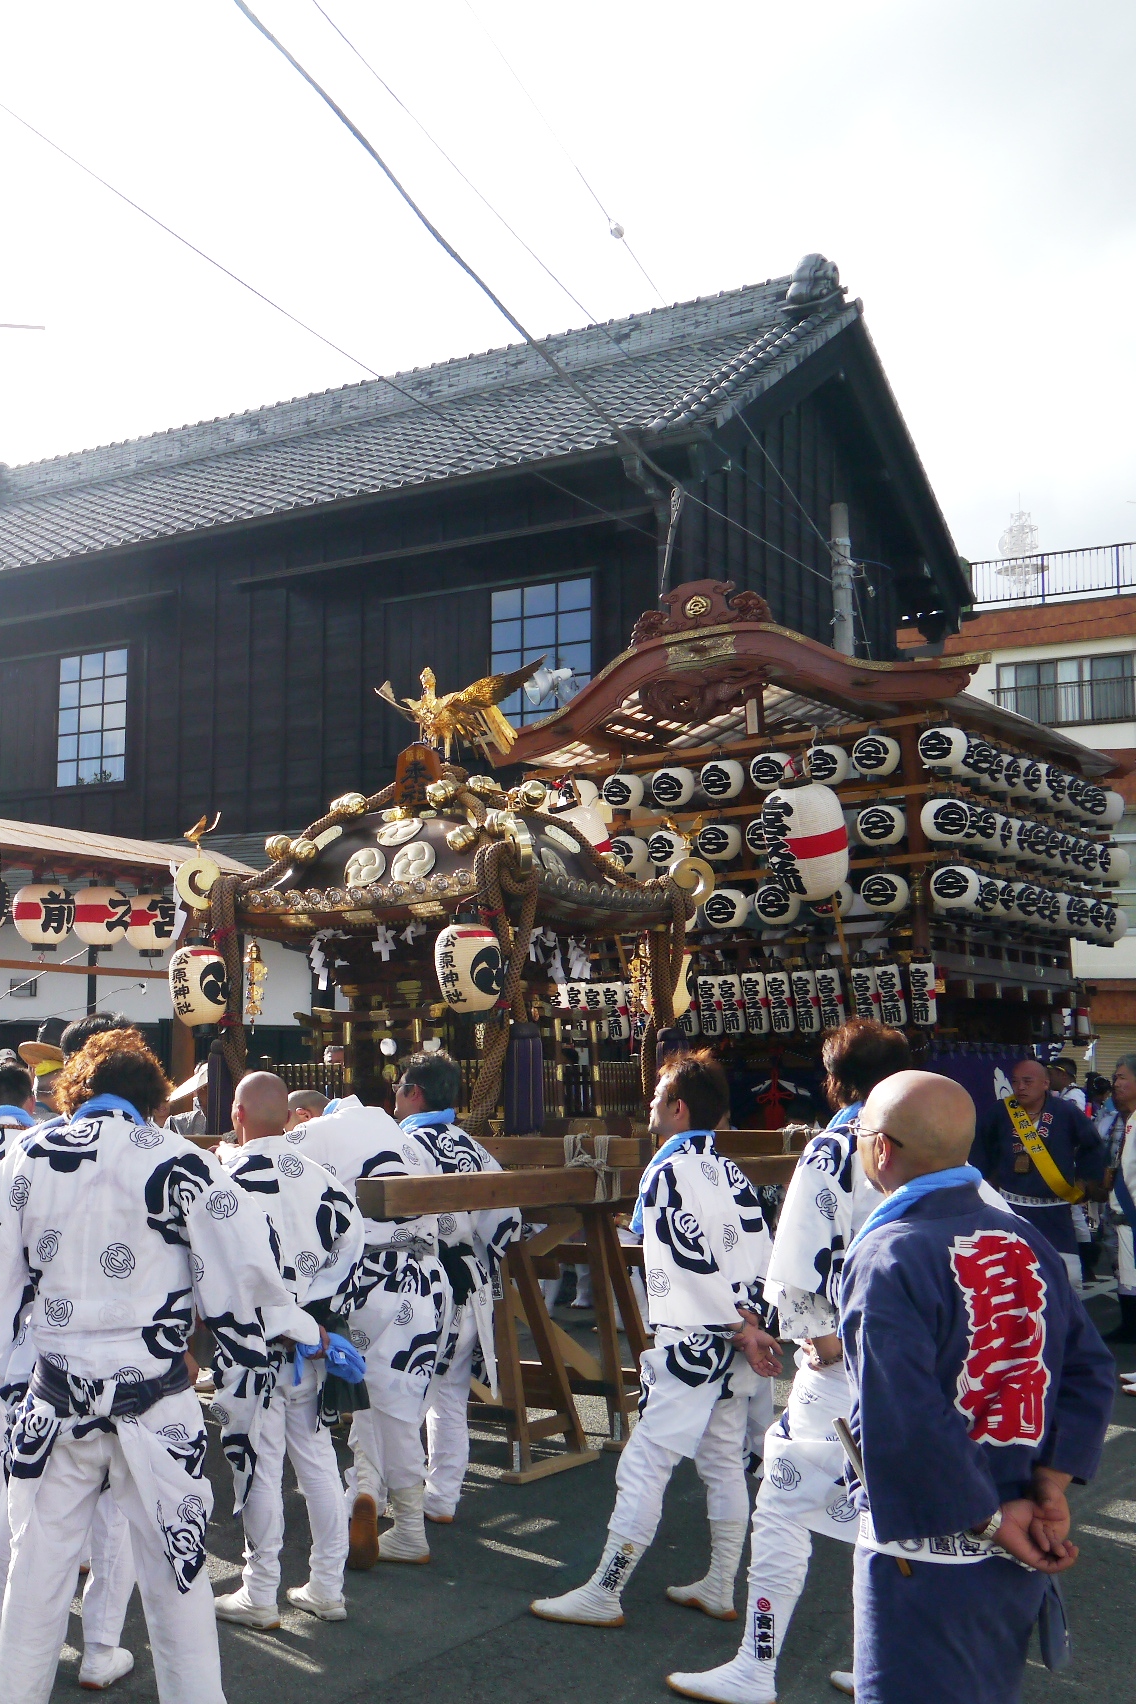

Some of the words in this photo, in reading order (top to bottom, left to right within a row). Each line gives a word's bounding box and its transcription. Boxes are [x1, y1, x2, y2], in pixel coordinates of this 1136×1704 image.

[854, 737, 889, 769] 宮
[919, 731, 953, 760] 宮
[652, 772, 683, 802] 宮
[701, 764, 731, 796] 宮
[752, 756, 783, 784] 宮
[698, 826, 729, 855] 宮
[859, 807, 895, 840] 宮
[933, 801, 969, 836] 宮
[763, 795, 808, 895] 宮之前
[861, 875, 898, 906] 宮
[933, 868, 969, 899] 宮
[40, 888, 76, 935] 前
[705, 893, 736, 924] 宮
[172, 953, 195, 1016] 松原神社
[439, 933, 467, 1005] 松原神社
[698, 979, 717, 1034] 宮之前
[718, 979, 740, 1032] 宮之前
[744, 977, 763, 1031] 宮之前
[767, 977, 790, 1030] 宮之前
[792, 976, 814, 1031] 宮之前
[816, 974, 840, 1031] 宮之前
[876, 970, 902, 1024] 宮之前
[910, 967, 930, 1023] 宮之前
[951, 1231, 1051, 1447] 宮之前
[755, 1613, 773, 1659] 宮之前
